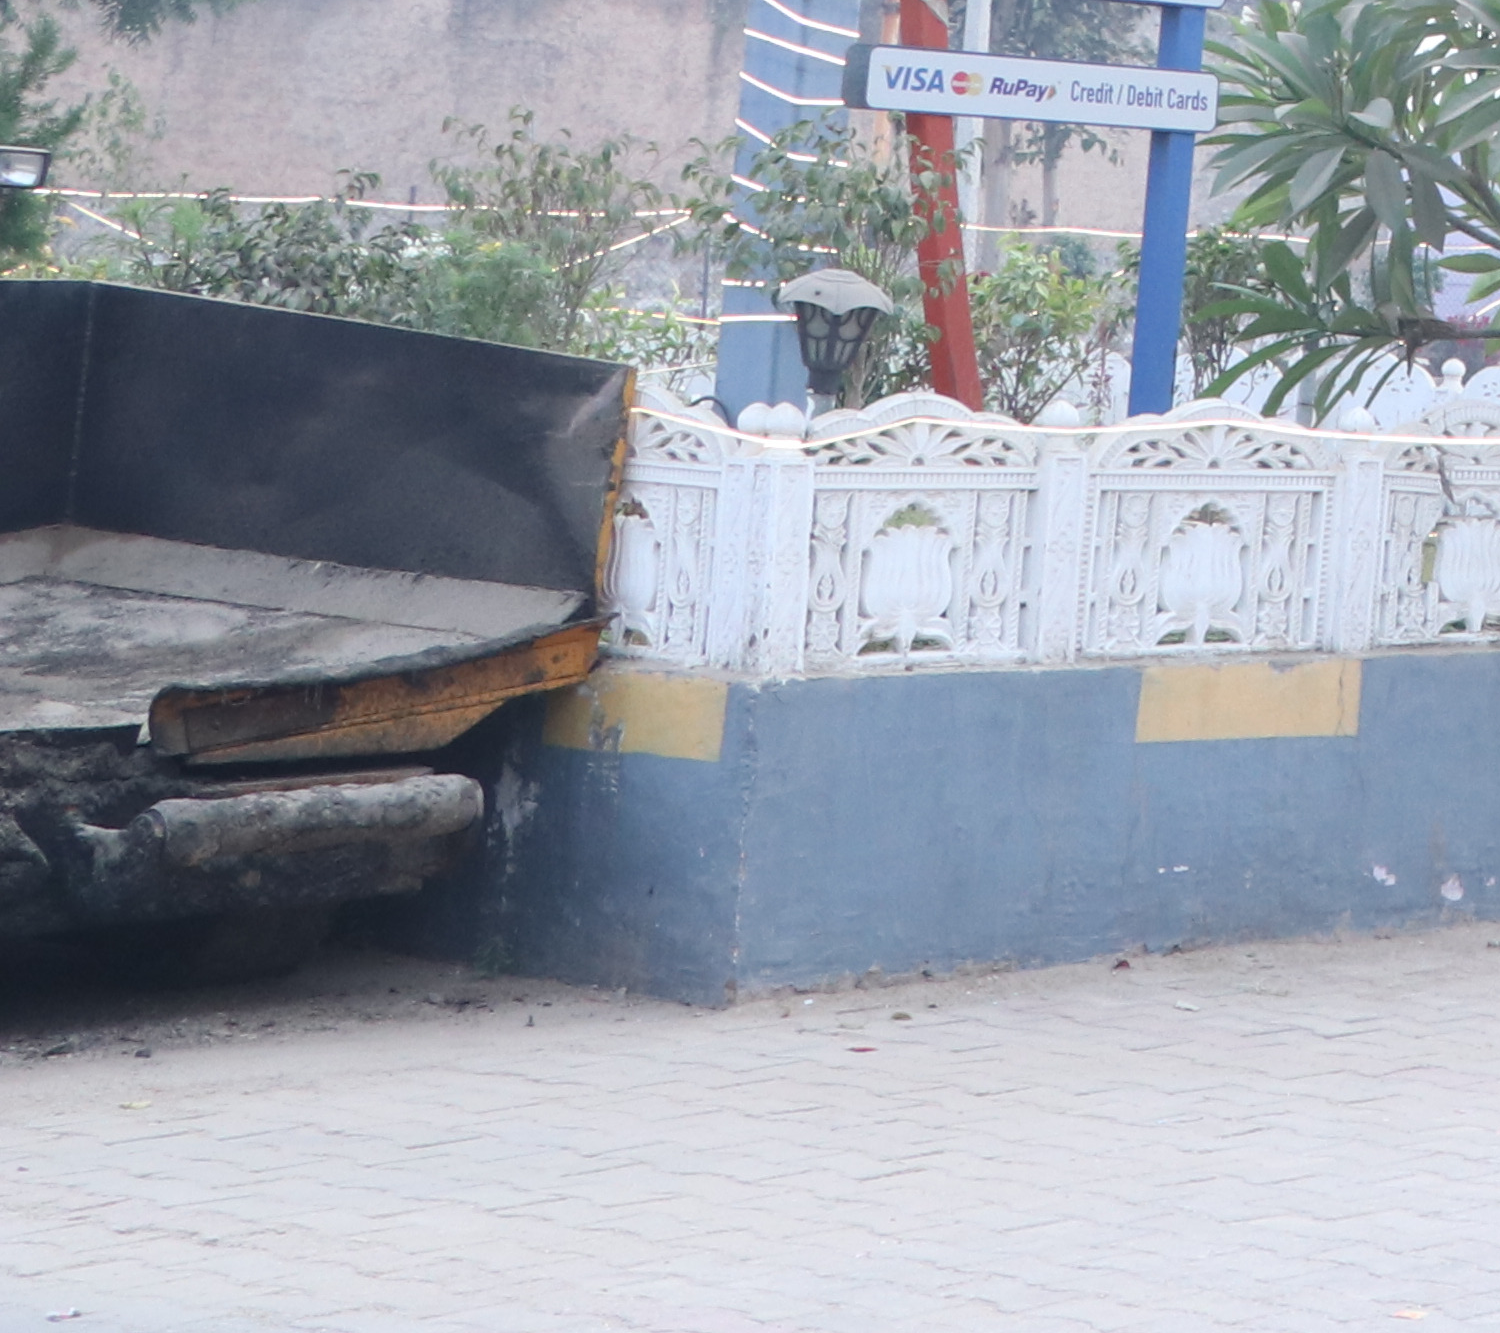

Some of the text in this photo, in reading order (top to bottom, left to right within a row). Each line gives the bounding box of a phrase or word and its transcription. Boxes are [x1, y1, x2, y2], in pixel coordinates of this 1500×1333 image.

[883, 65, 1209, 112] VISA RuPay Credit / Debit Cards
